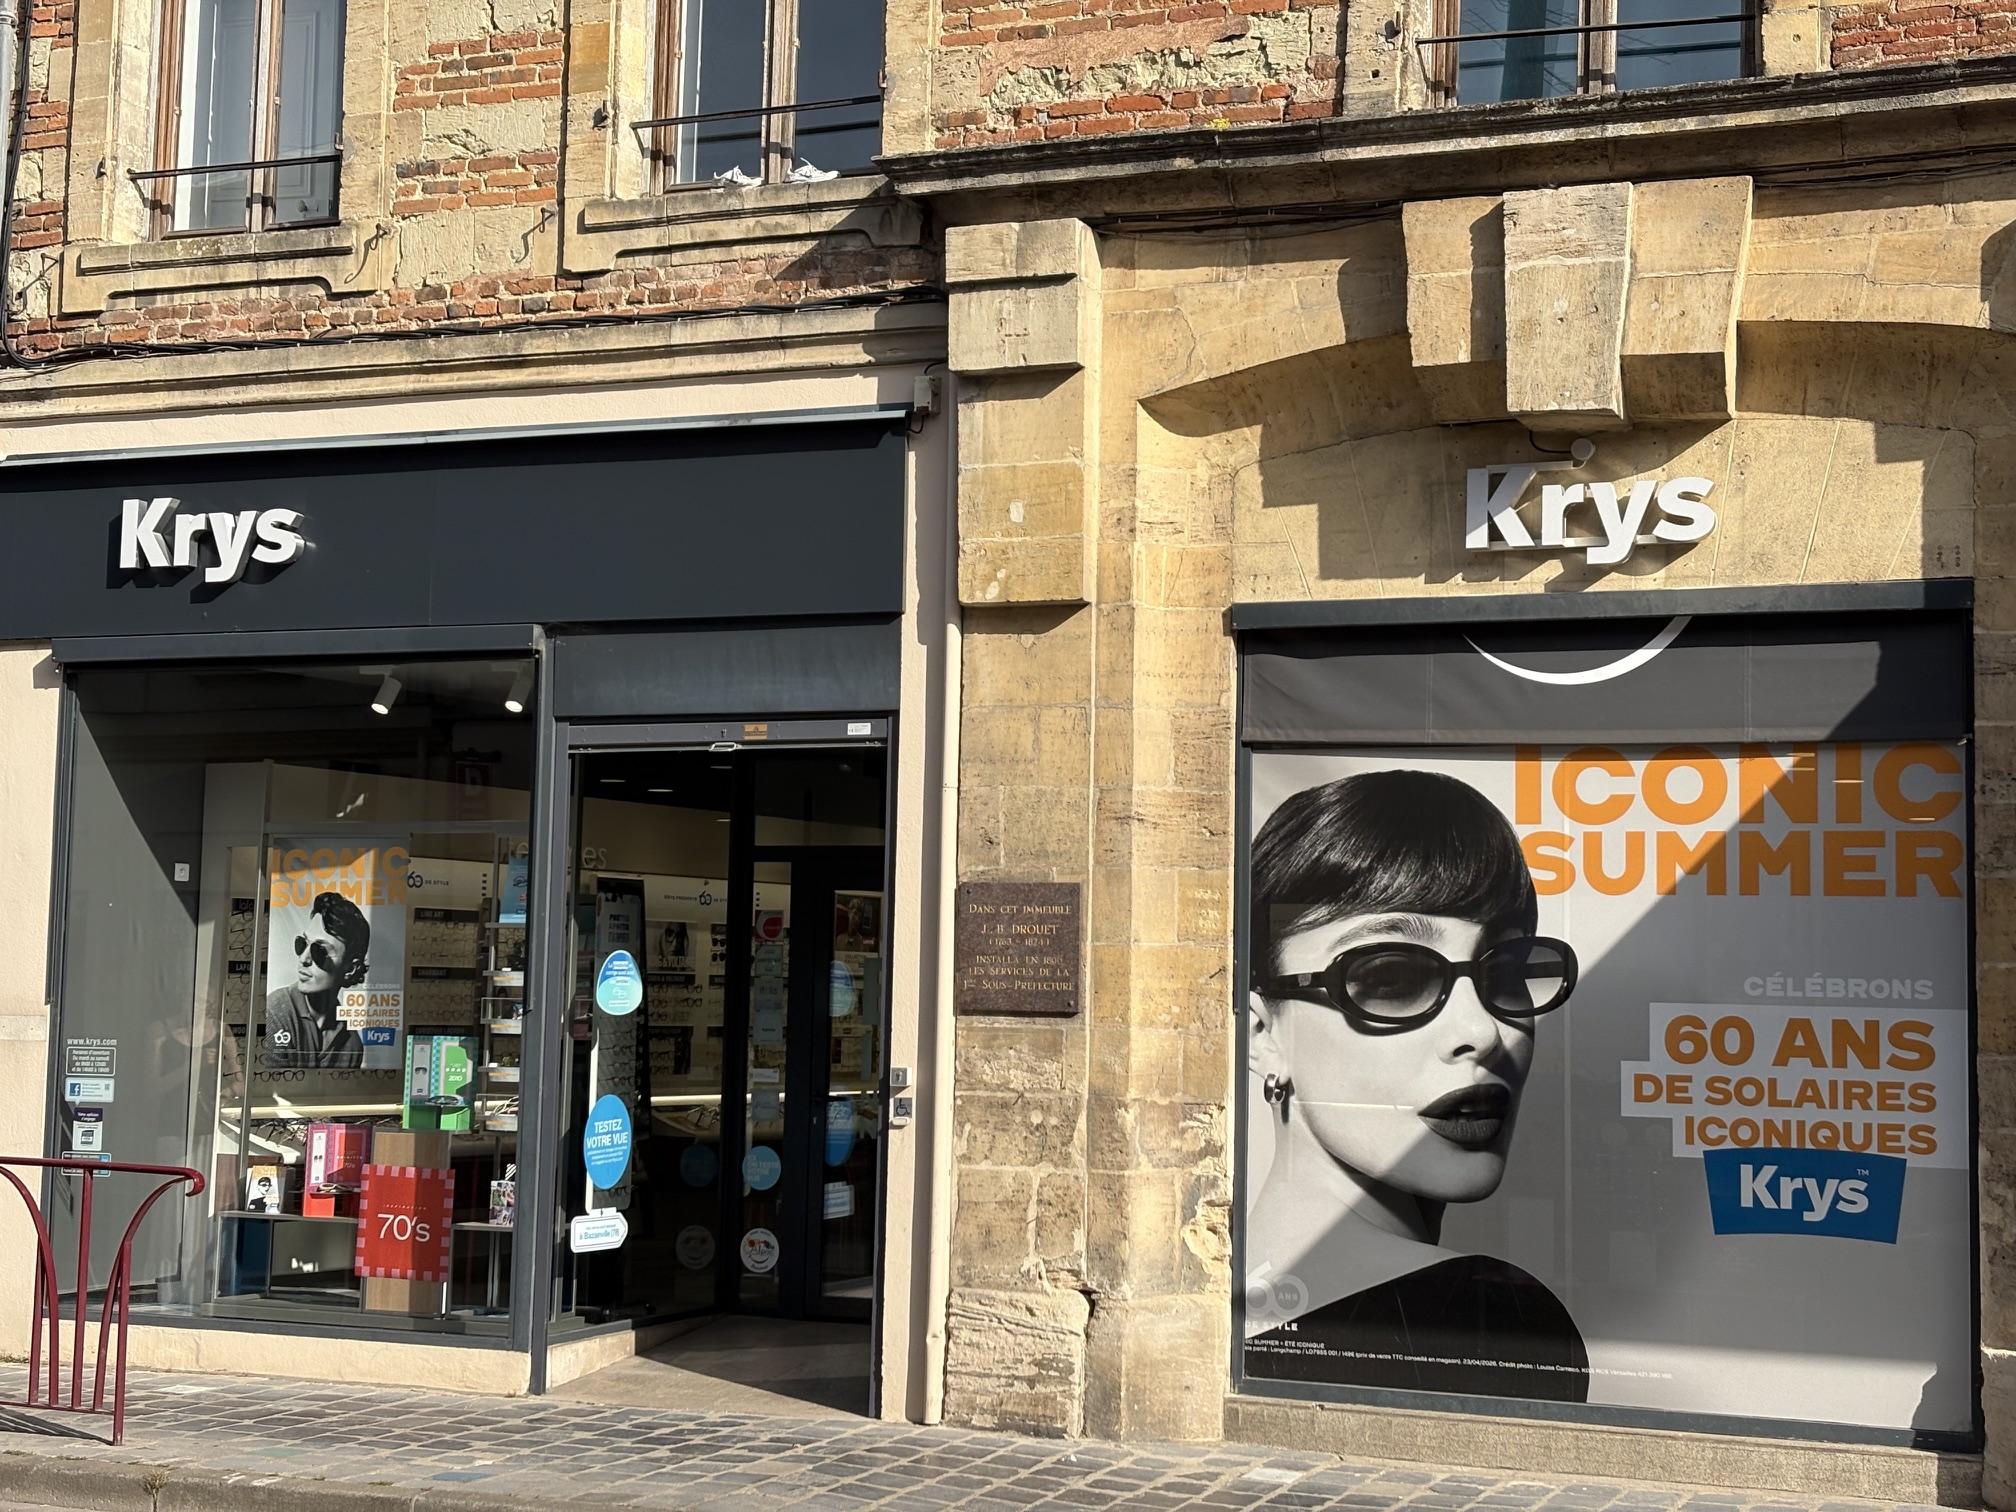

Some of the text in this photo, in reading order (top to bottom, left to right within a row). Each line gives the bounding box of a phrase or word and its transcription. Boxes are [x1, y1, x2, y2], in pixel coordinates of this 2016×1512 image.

[1466, 467, 1717, 565] Krys
[120, 497, 305, 583] Krys
[1514, 744, 1964, 826] ICONIC
[271, 846, 409, 880] ICONIC
[1519, 830, 1964, 898] SUMMER
[271, 879, 408, 908] SUMMER
[1000, 905, 1019, 914] CET
[1023, 905, 1072, 915] IMMEUBLE
[1012, 924, 1057, 935] DROUET
[976, 955, 1019, 964] INSTALLA
[1025, 955, 1038, 964] EN
[969, 967, 1069, 977] LES SERVICES DE LA
[1744, 971, 1934, 1000] CÉLÉBRONS
[347, 993, 400, 1007] 60 ANS
[339, 1008, 400, 1018] DE SOLAIRES
[350, 1019, 400, 1028] ICONIQUES
[67, 1038, 117, 1047] www.krys.com
[367, 1030, 390, 1043] Krys
[1664, 1014, 1936, 1071] 60 ANS
[1633, 1073, 1937, 1113] DE SOLAIRES
[594, 1118, 623, 1134] TESTEZ
[1685, 1116, 1938, 1155] ICONIQUES
[586, 1131, 629, 1149] VOTRE VUE
[1740, 1164, 1869, 1222] Krys
[377, 1213, 431, 1243] 70's
[1296, 1341, 1325, 1349] ICONIQUE
